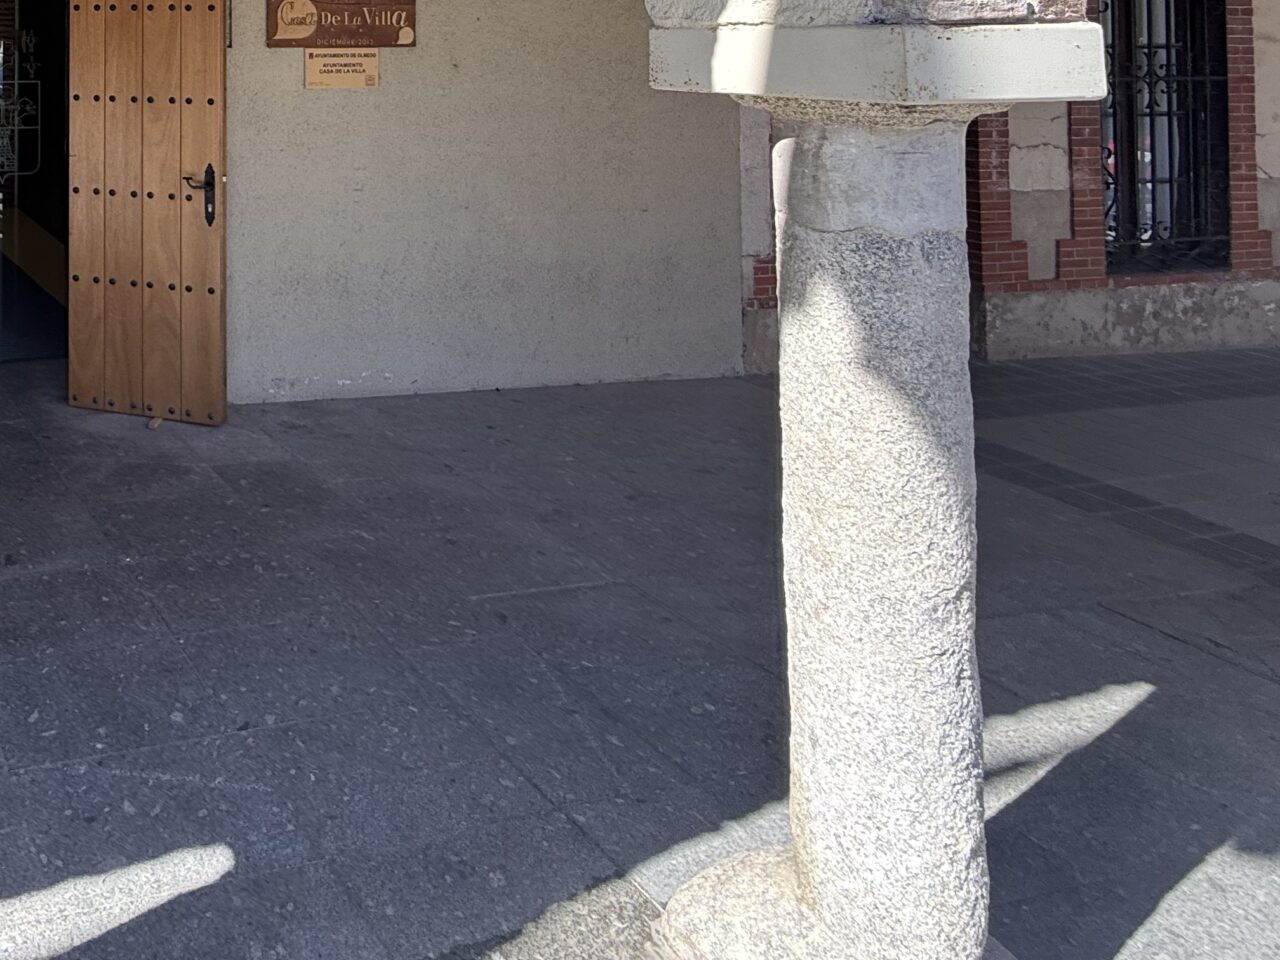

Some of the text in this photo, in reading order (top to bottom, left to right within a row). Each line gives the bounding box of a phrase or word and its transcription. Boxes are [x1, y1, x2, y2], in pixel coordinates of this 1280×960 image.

[321, 12, 340, 25] De
[344, 12, 363, 25] La
[363, 7, 408, 27] Villa
